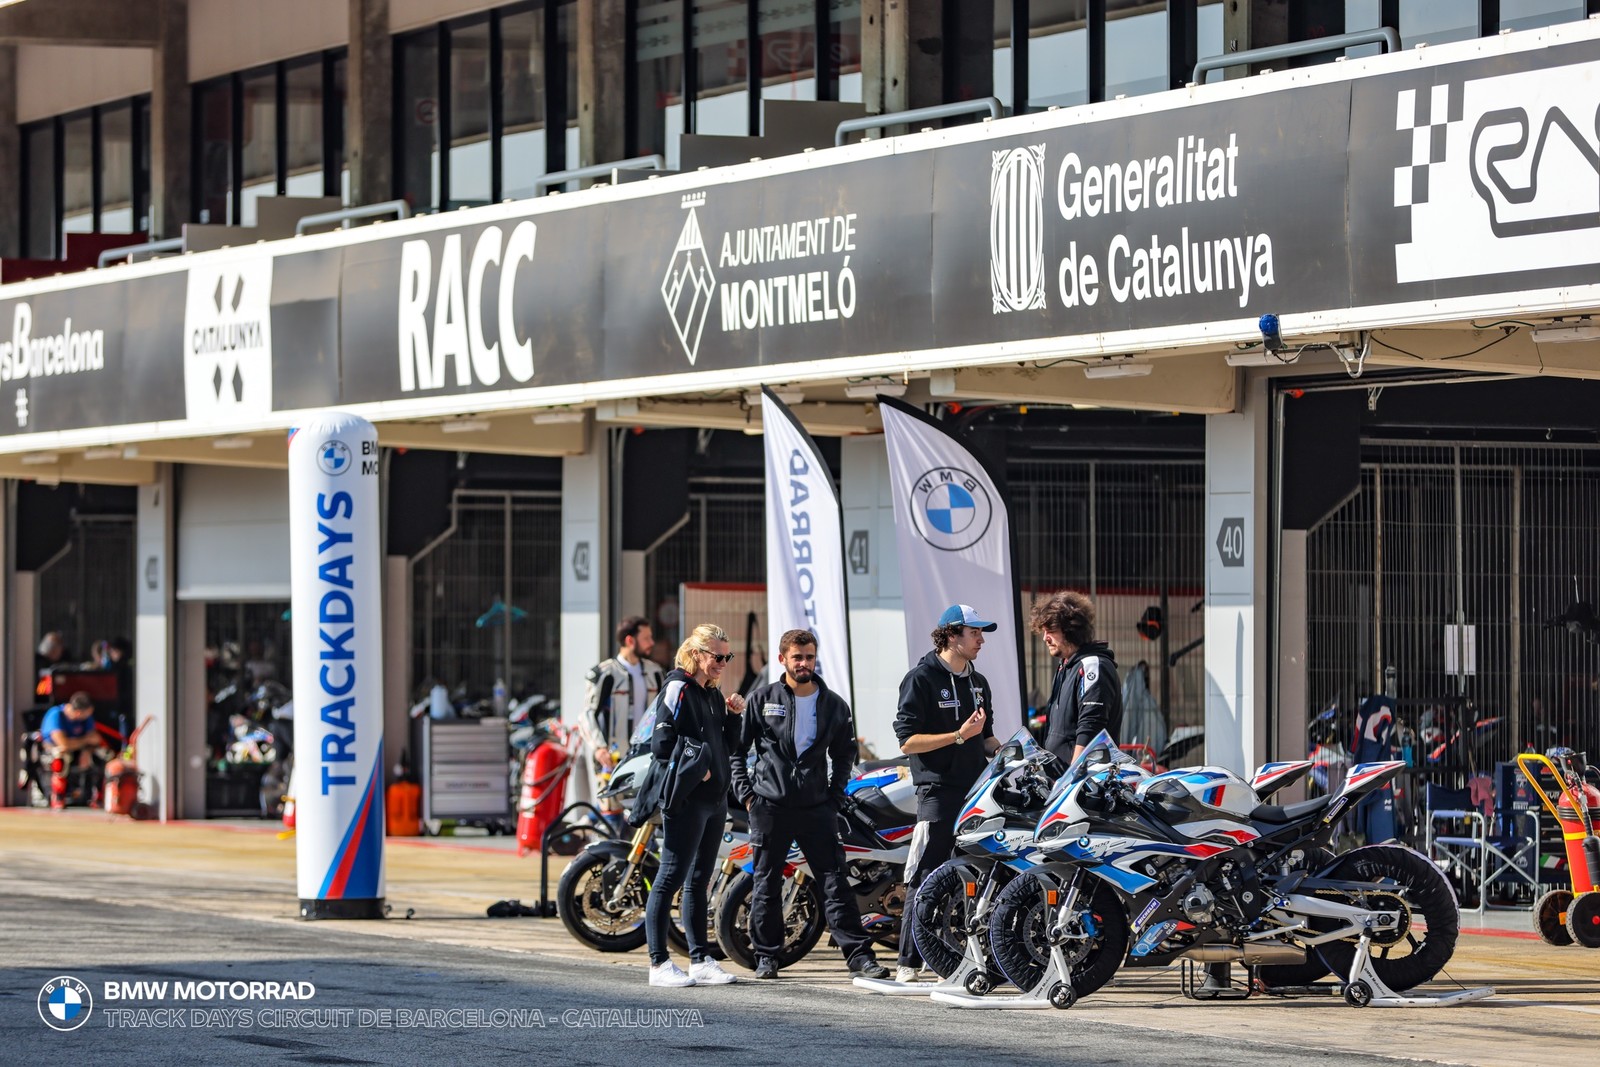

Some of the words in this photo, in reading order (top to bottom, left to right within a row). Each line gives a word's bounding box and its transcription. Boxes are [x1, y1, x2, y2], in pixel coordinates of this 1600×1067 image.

[1057, 133, 1239, 220] Generalitat
[719, 216, 831, 268] AJUNTAMENT
[832, 213, 858, 253] DE
[1058, 241, 1099, 308] de
[1108, 226, 1275, 308] Catalunya
[398, 220, 537, 392] RACC
[720, 255, 857, 332] MONTMELÓ
[192, 322, 263, 354] CATALUNYA
[852, 538, 867, 562] 41
[1223, 526, 1243, 559] 40
[317, 491, 356, 795] TRACKDAYS
